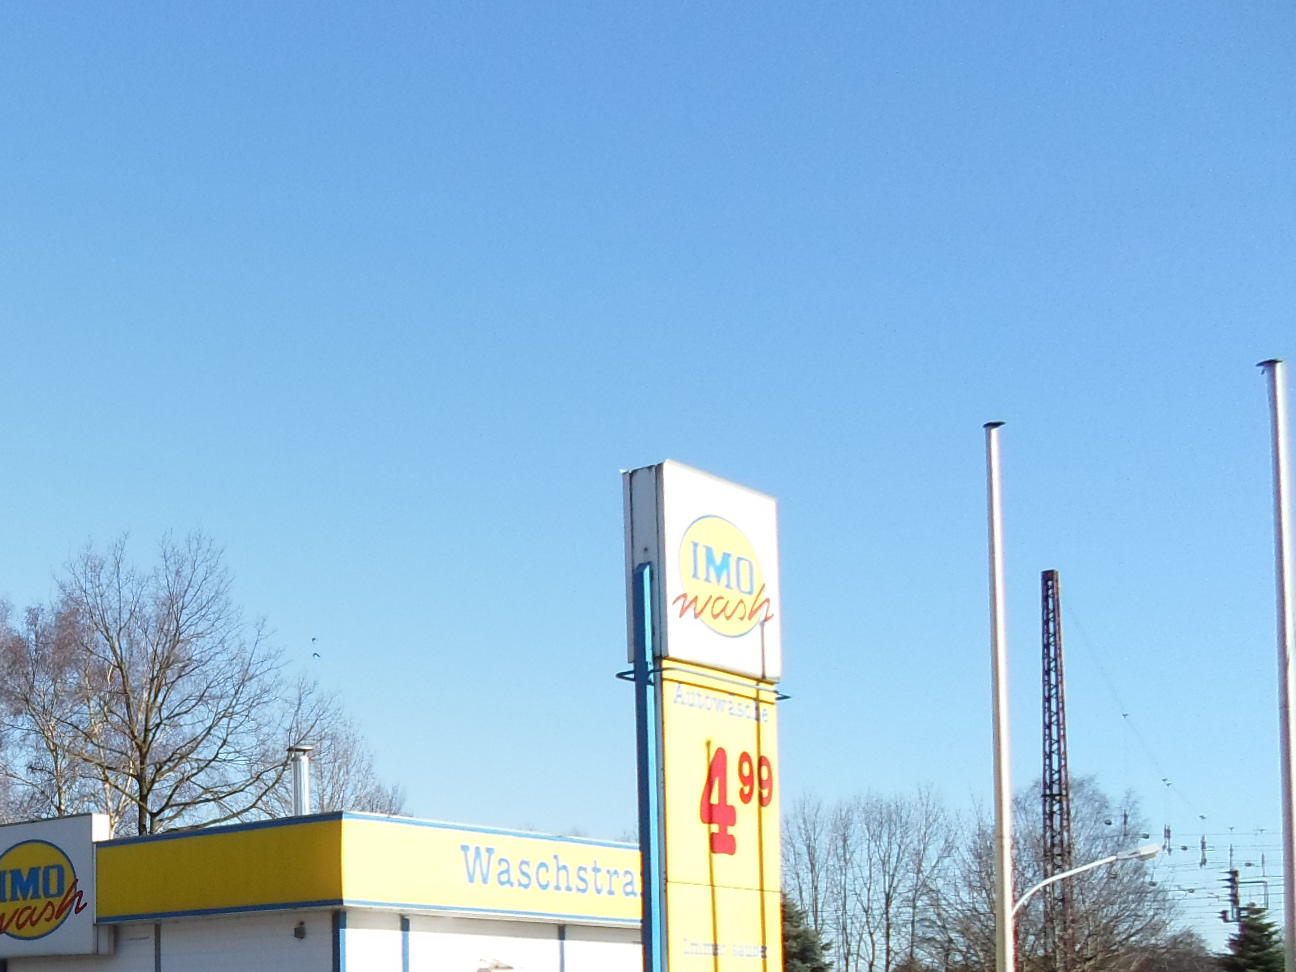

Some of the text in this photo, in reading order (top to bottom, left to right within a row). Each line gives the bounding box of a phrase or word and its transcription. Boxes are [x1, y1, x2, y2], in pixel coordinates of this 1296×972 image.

[690, 540, 754, 595] IMO
[672, 583, 774, 622] wash
[460, 844, 642, 898] Waschstra
